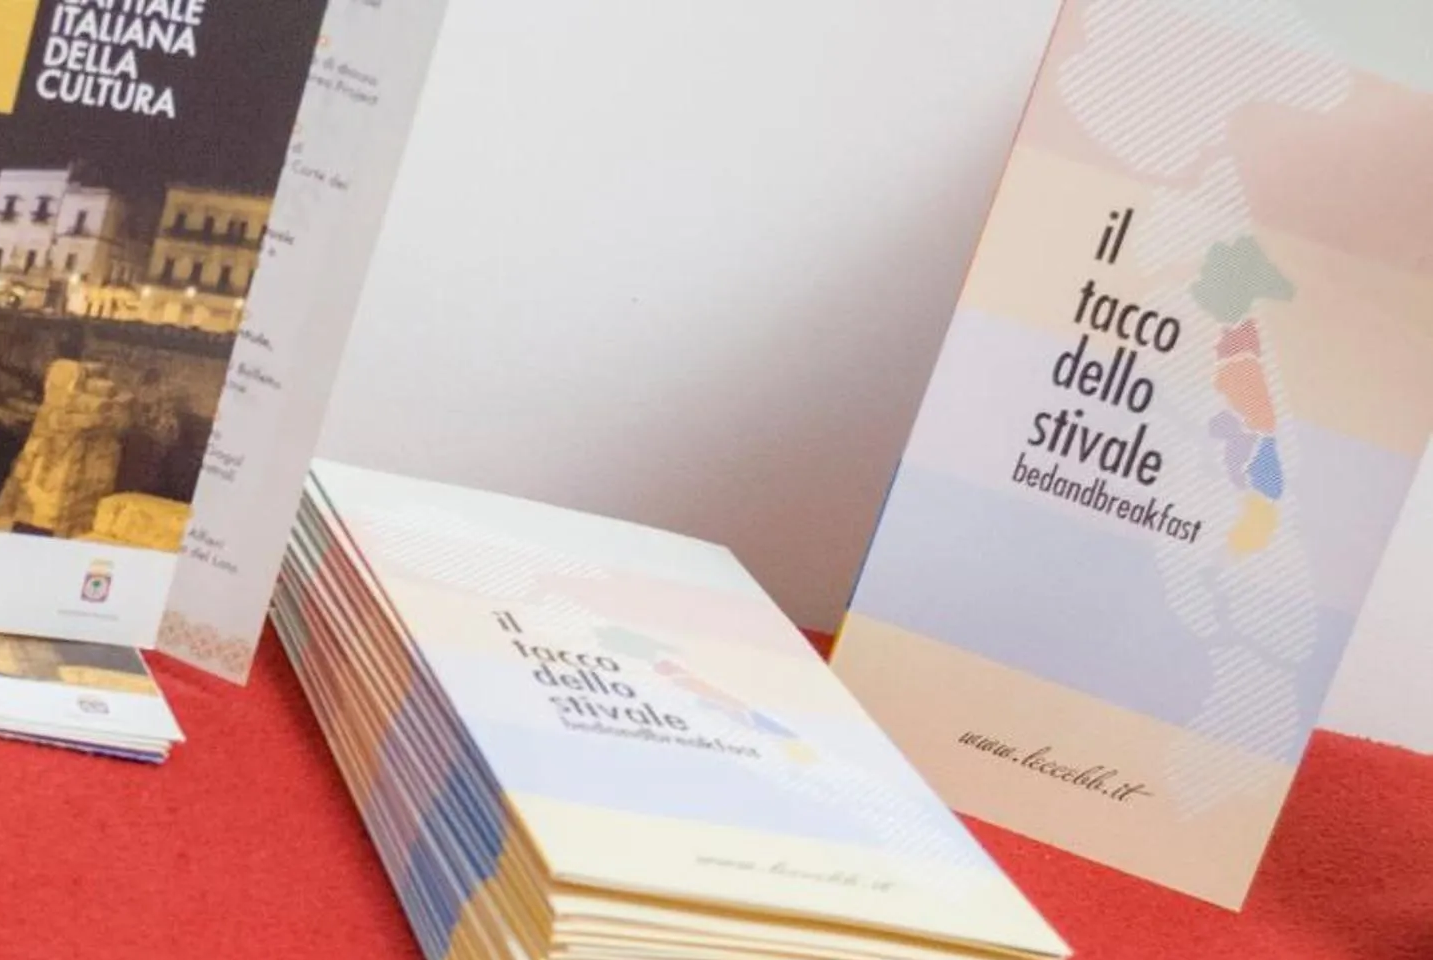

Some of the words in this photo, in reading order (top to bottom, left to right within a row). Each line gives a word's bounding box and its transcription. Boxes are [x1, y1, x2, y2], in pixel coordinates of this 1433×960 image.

[51, 4, 197, 58] ITALIANA
[43, 36, 138, 80] DELLA
[36, 68, 176, 119] CULTURA
[1094, 208, 1134, 264] il
[1074, 280, 1180, 353] tacco
[1052, 334, 1155, 414] dello
[1027, 409, 1163, 487] stivale
[1012, 453, 1203, 544] bedandbreakfast
[492, 611, 523, 634] il
[512, 639, 620, 673] tacco
[532, 664, 637, 699] dello
[549, 696, 690, 731] stivale
